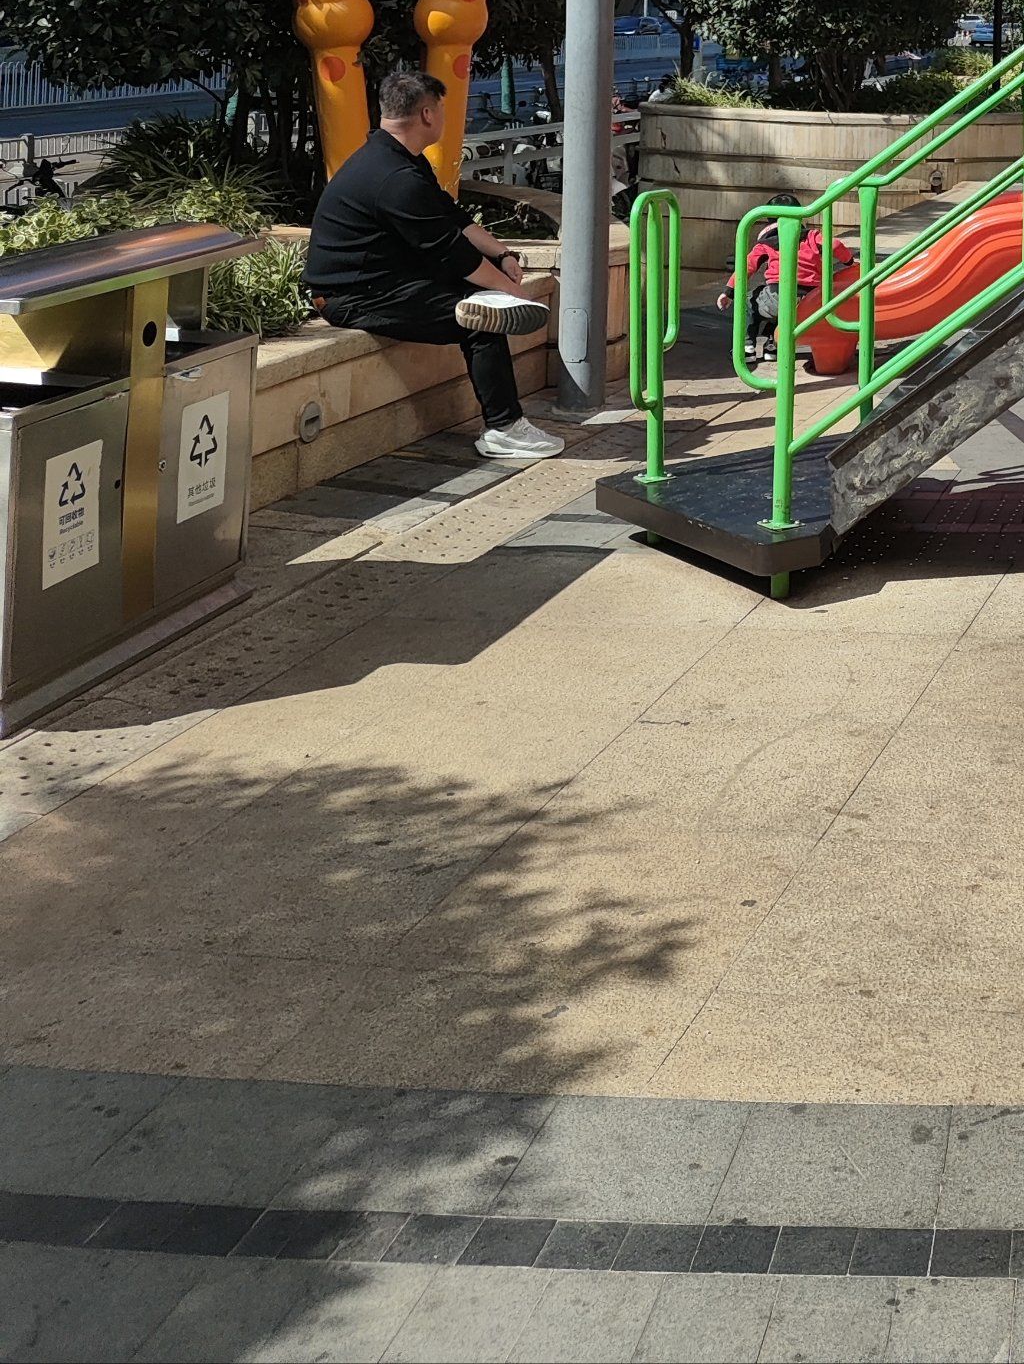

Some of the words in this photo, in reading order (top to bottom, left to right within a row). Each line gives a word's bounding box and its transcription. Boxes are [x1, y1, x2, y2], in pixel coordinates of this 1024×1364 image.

[187, 477, 216, 498] 其他垃圾
[58, 507, 85, 526] 可回收物
